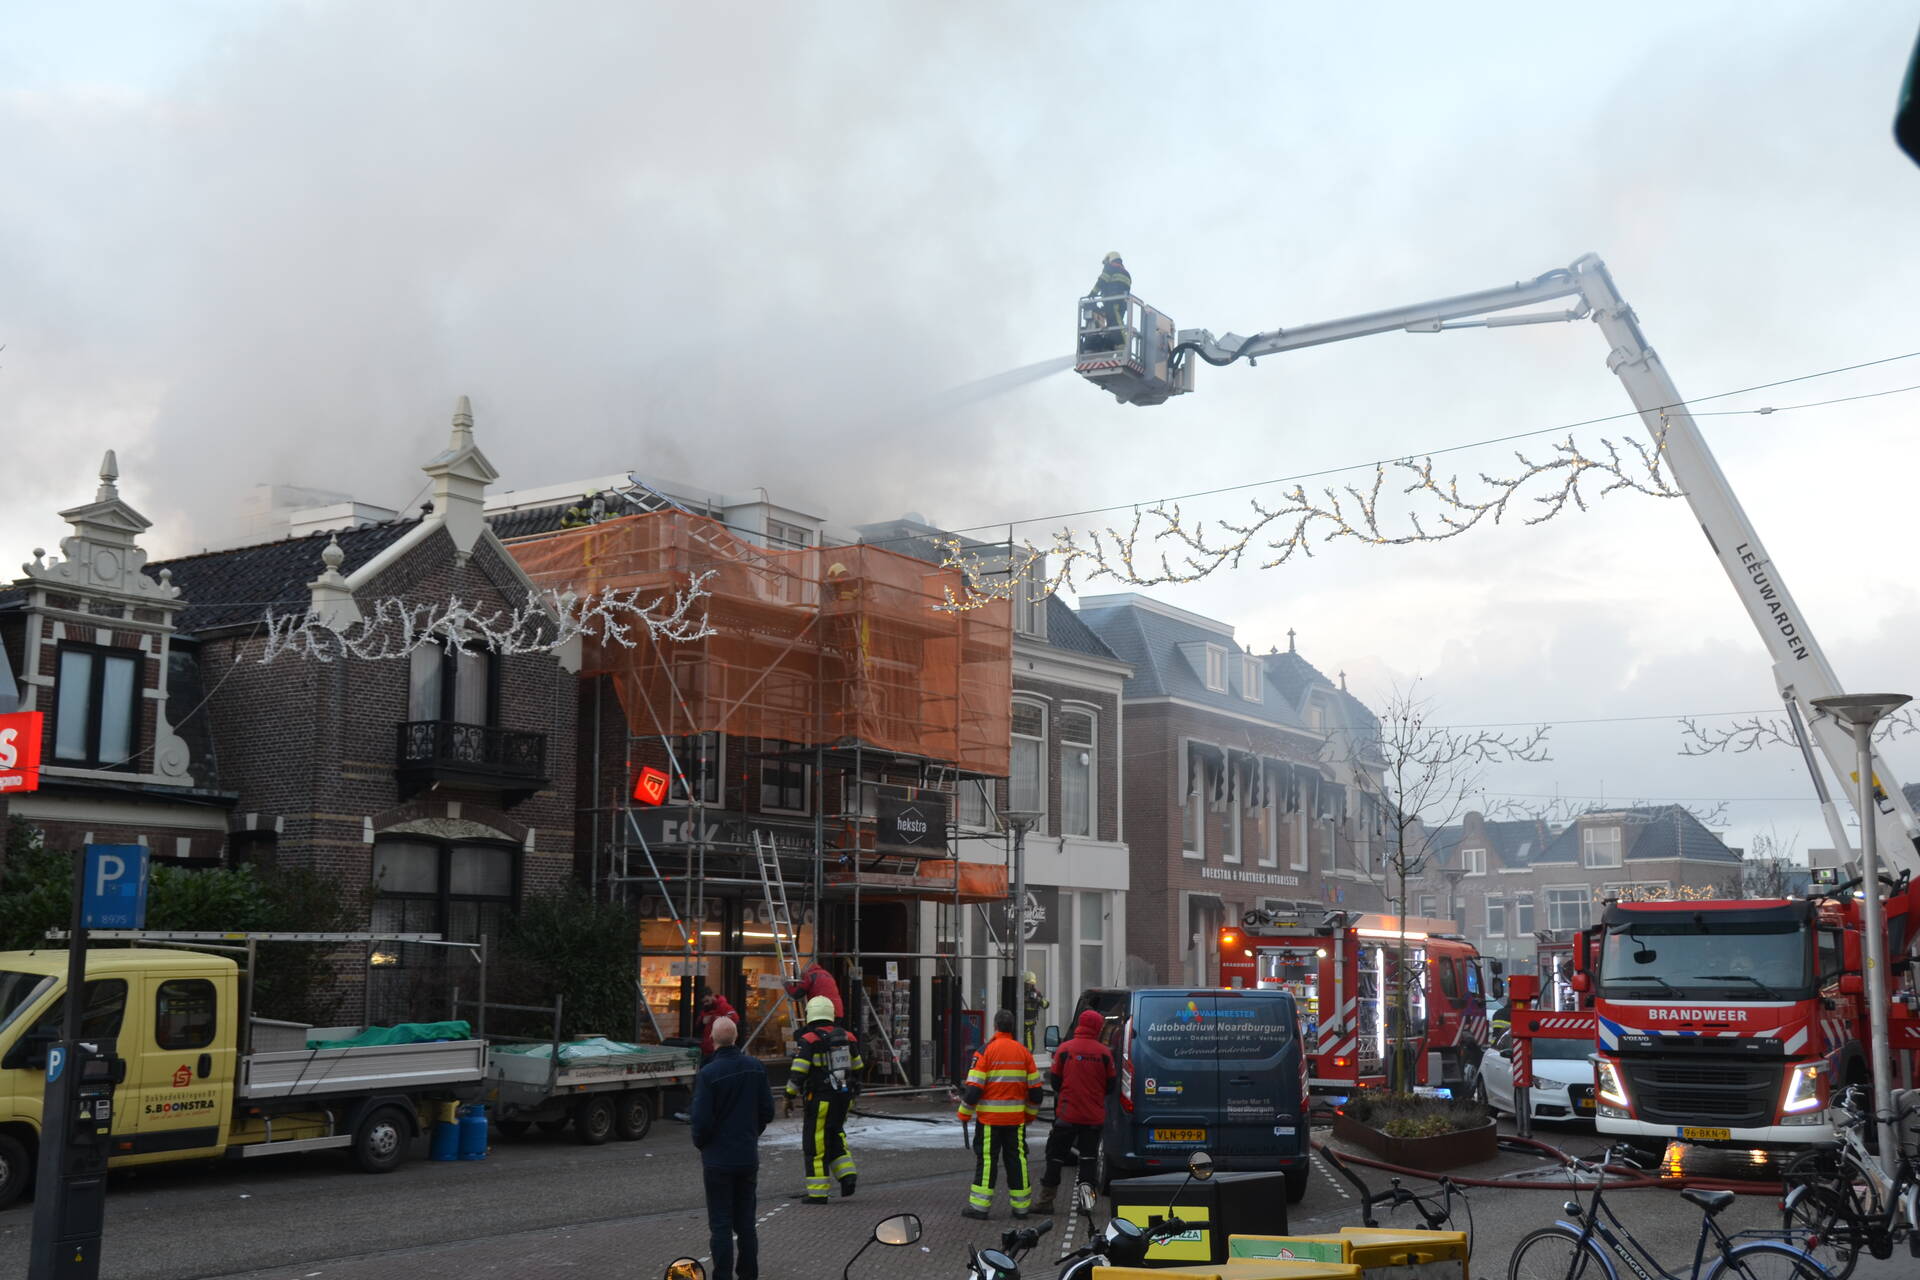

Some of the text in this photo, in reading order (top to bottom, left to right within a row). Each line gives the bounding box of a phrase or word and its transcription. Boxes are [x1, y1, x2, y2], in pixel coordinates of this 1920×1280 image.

[1736, 542, 1809, 661] LEEUWARDEN
[897, 816, 927, 833] hekstra
[96, 855, 126, 897] P
[1175, 1010, 1255, 1018] AUTOVAKMEESTER
[1648, 1008, 1747, 1022] BRANDWEER
[1147, 1022, 1286, 1034] Autobedriuw Noardburgum
[48, 1050, 61, 1076] P
[145, 1099, 215, 1114] S.BOONSTRA
[1156, 1130, 1203, 1141] VLN-99-R
[1685, 1128, 1728, 1138] 96-BKN-9
